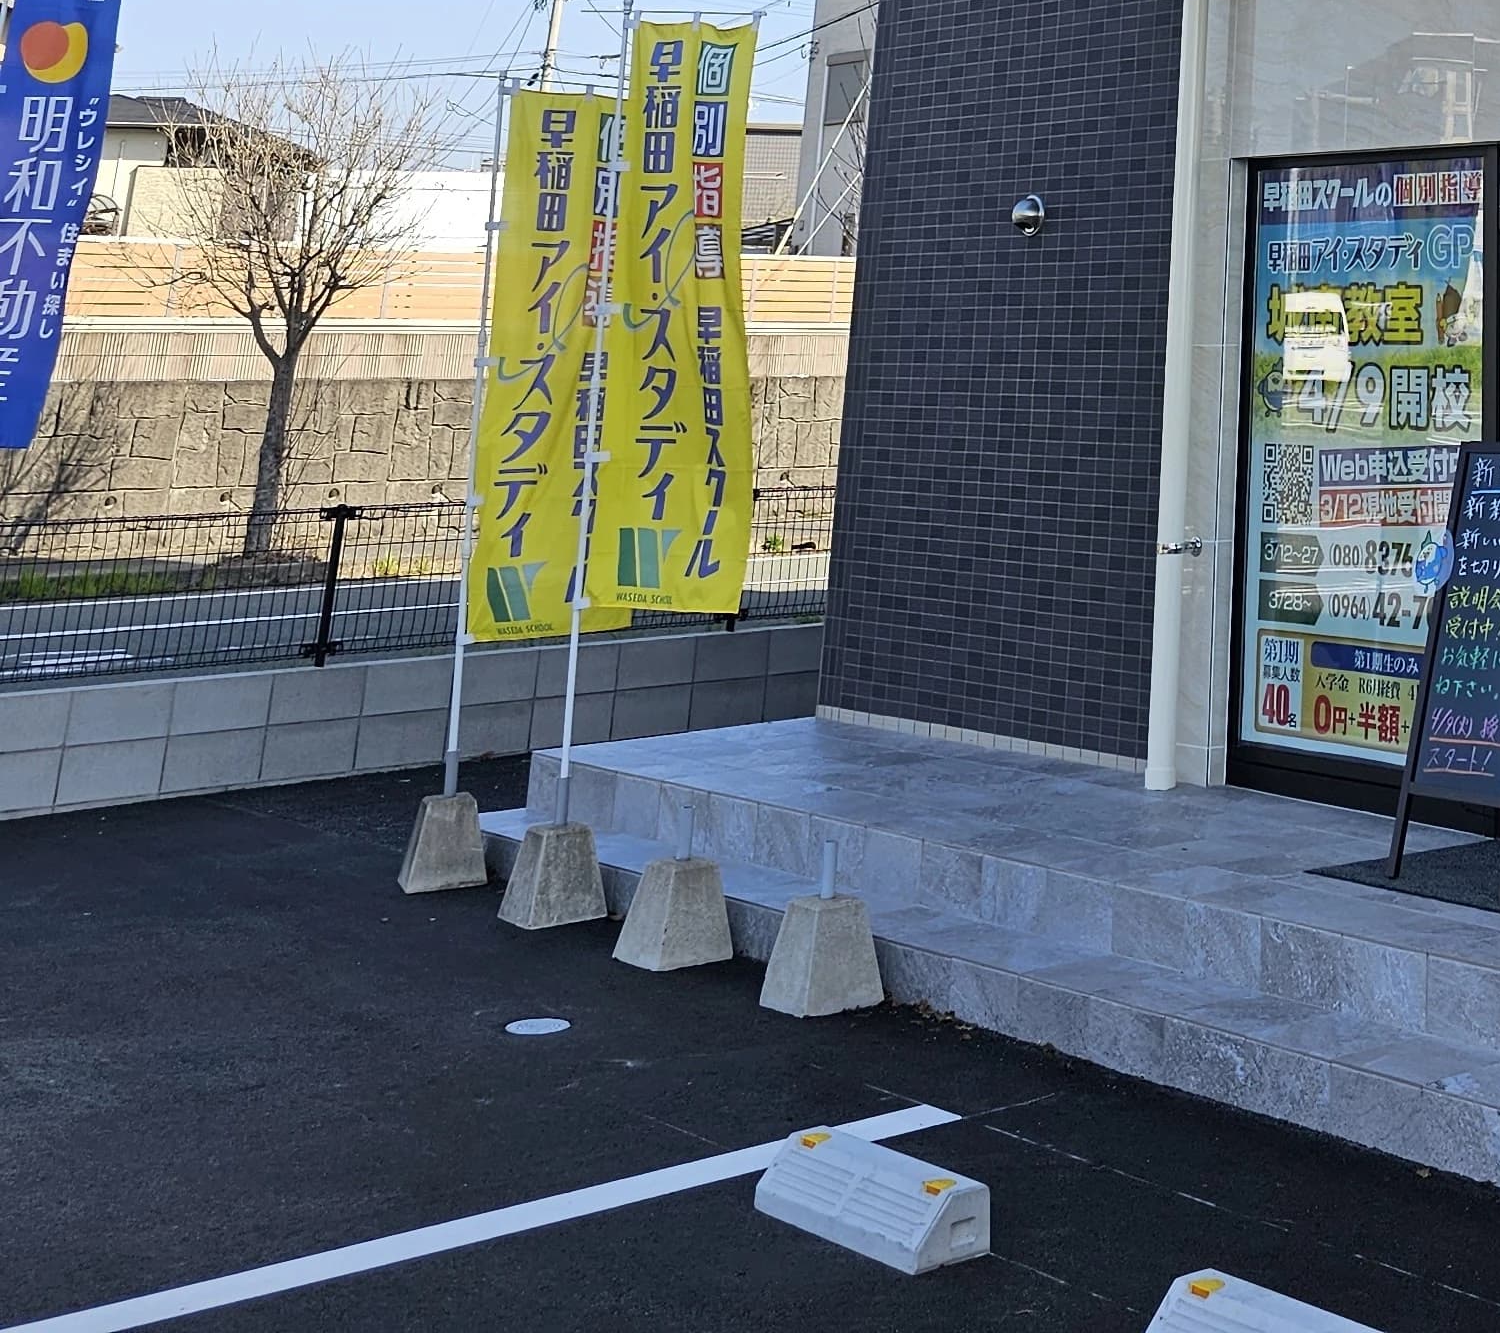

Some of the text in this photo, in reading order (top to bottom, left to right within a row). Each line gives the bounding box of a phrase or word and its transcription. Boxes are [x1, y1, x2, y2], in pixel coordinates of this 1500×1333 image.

[692, 42, 739, 280] 個別指導
[1263, 171, 1483, 212] 早稲田スクールの個別指導
[0, 95, 73, 402] 明和不動
[635, 40, 688, 521] 早稲田アイ・スタディ
[494, 109, 577, 558] 早稲田アイ・スタディ
[684, 306, 727, 579] 早稲田スクール
[525, 624, 553, 633] SCHOOL
[616, 592, 647, 603] WASEDA
[1262, 683, 1297, 728] 40名
[1315, 672, 1350, 692] 入学金
